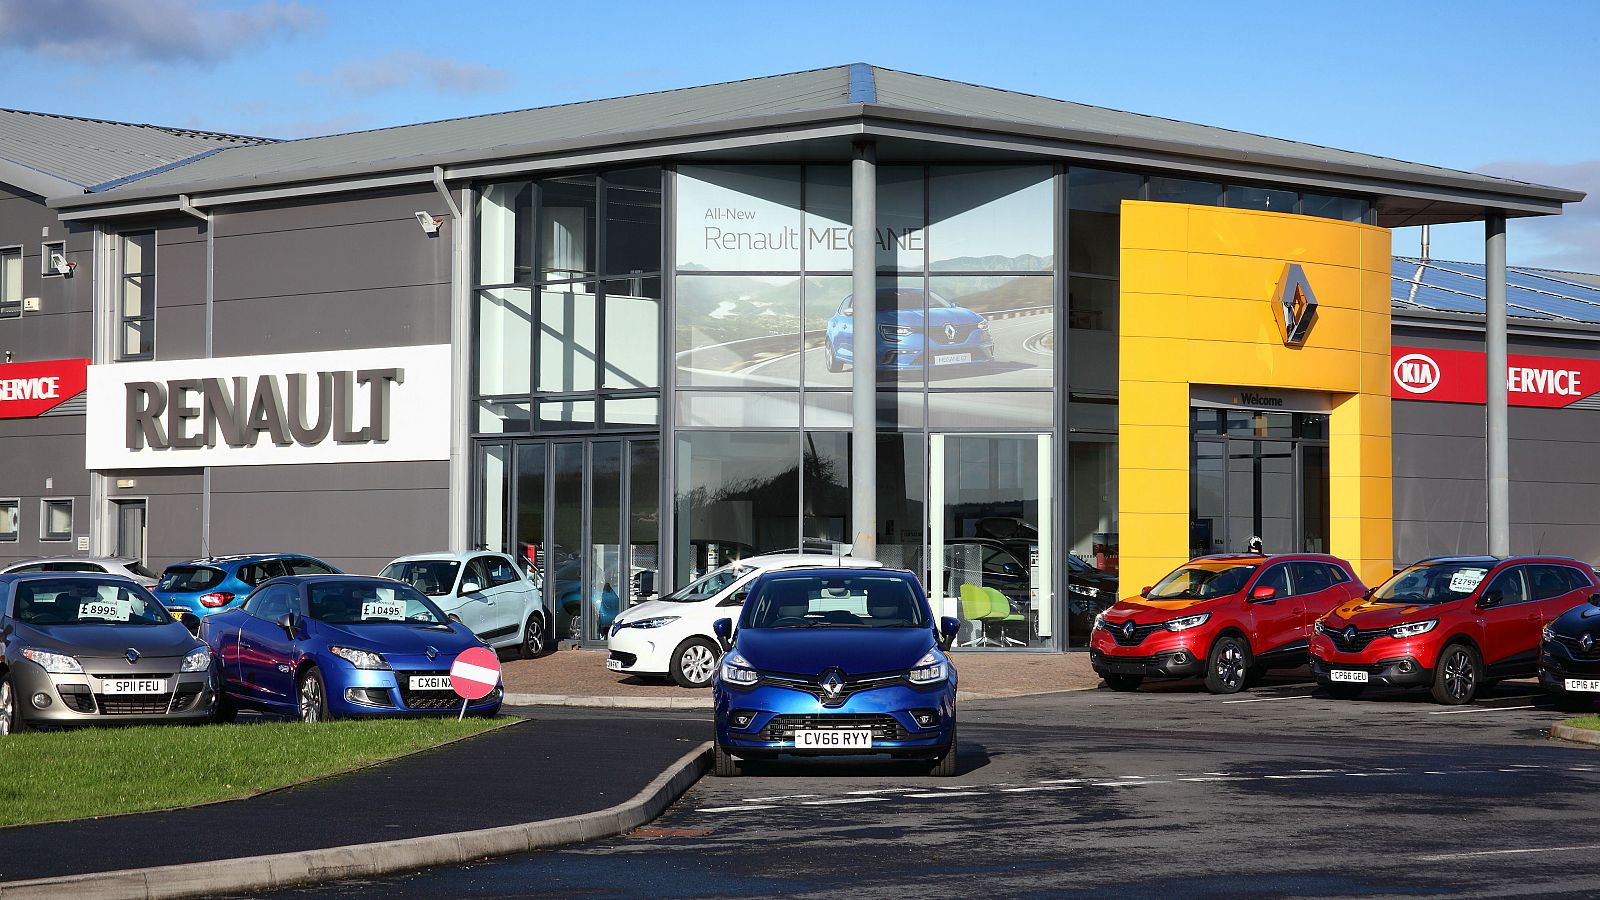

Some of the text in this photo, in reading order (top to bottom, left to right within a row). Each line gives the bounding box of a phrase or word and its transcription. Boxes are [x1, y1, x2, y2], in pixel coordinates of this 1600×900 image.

[704, 208, 756, 220] All-New
[704, 226, 924, 251] Renault MEANE
[1402, 362, 1432, 383] KIA
[1506, 366, 1582, 396] ERVICE
[1240, 392, 1283, 406] Welcome
[125, 368, 404, 451] RENAULT
[138, 681, 159, 691] FEU
[418, 678, 440, 688] CX61
[804, 732, 869, 745] CV66 RYY
